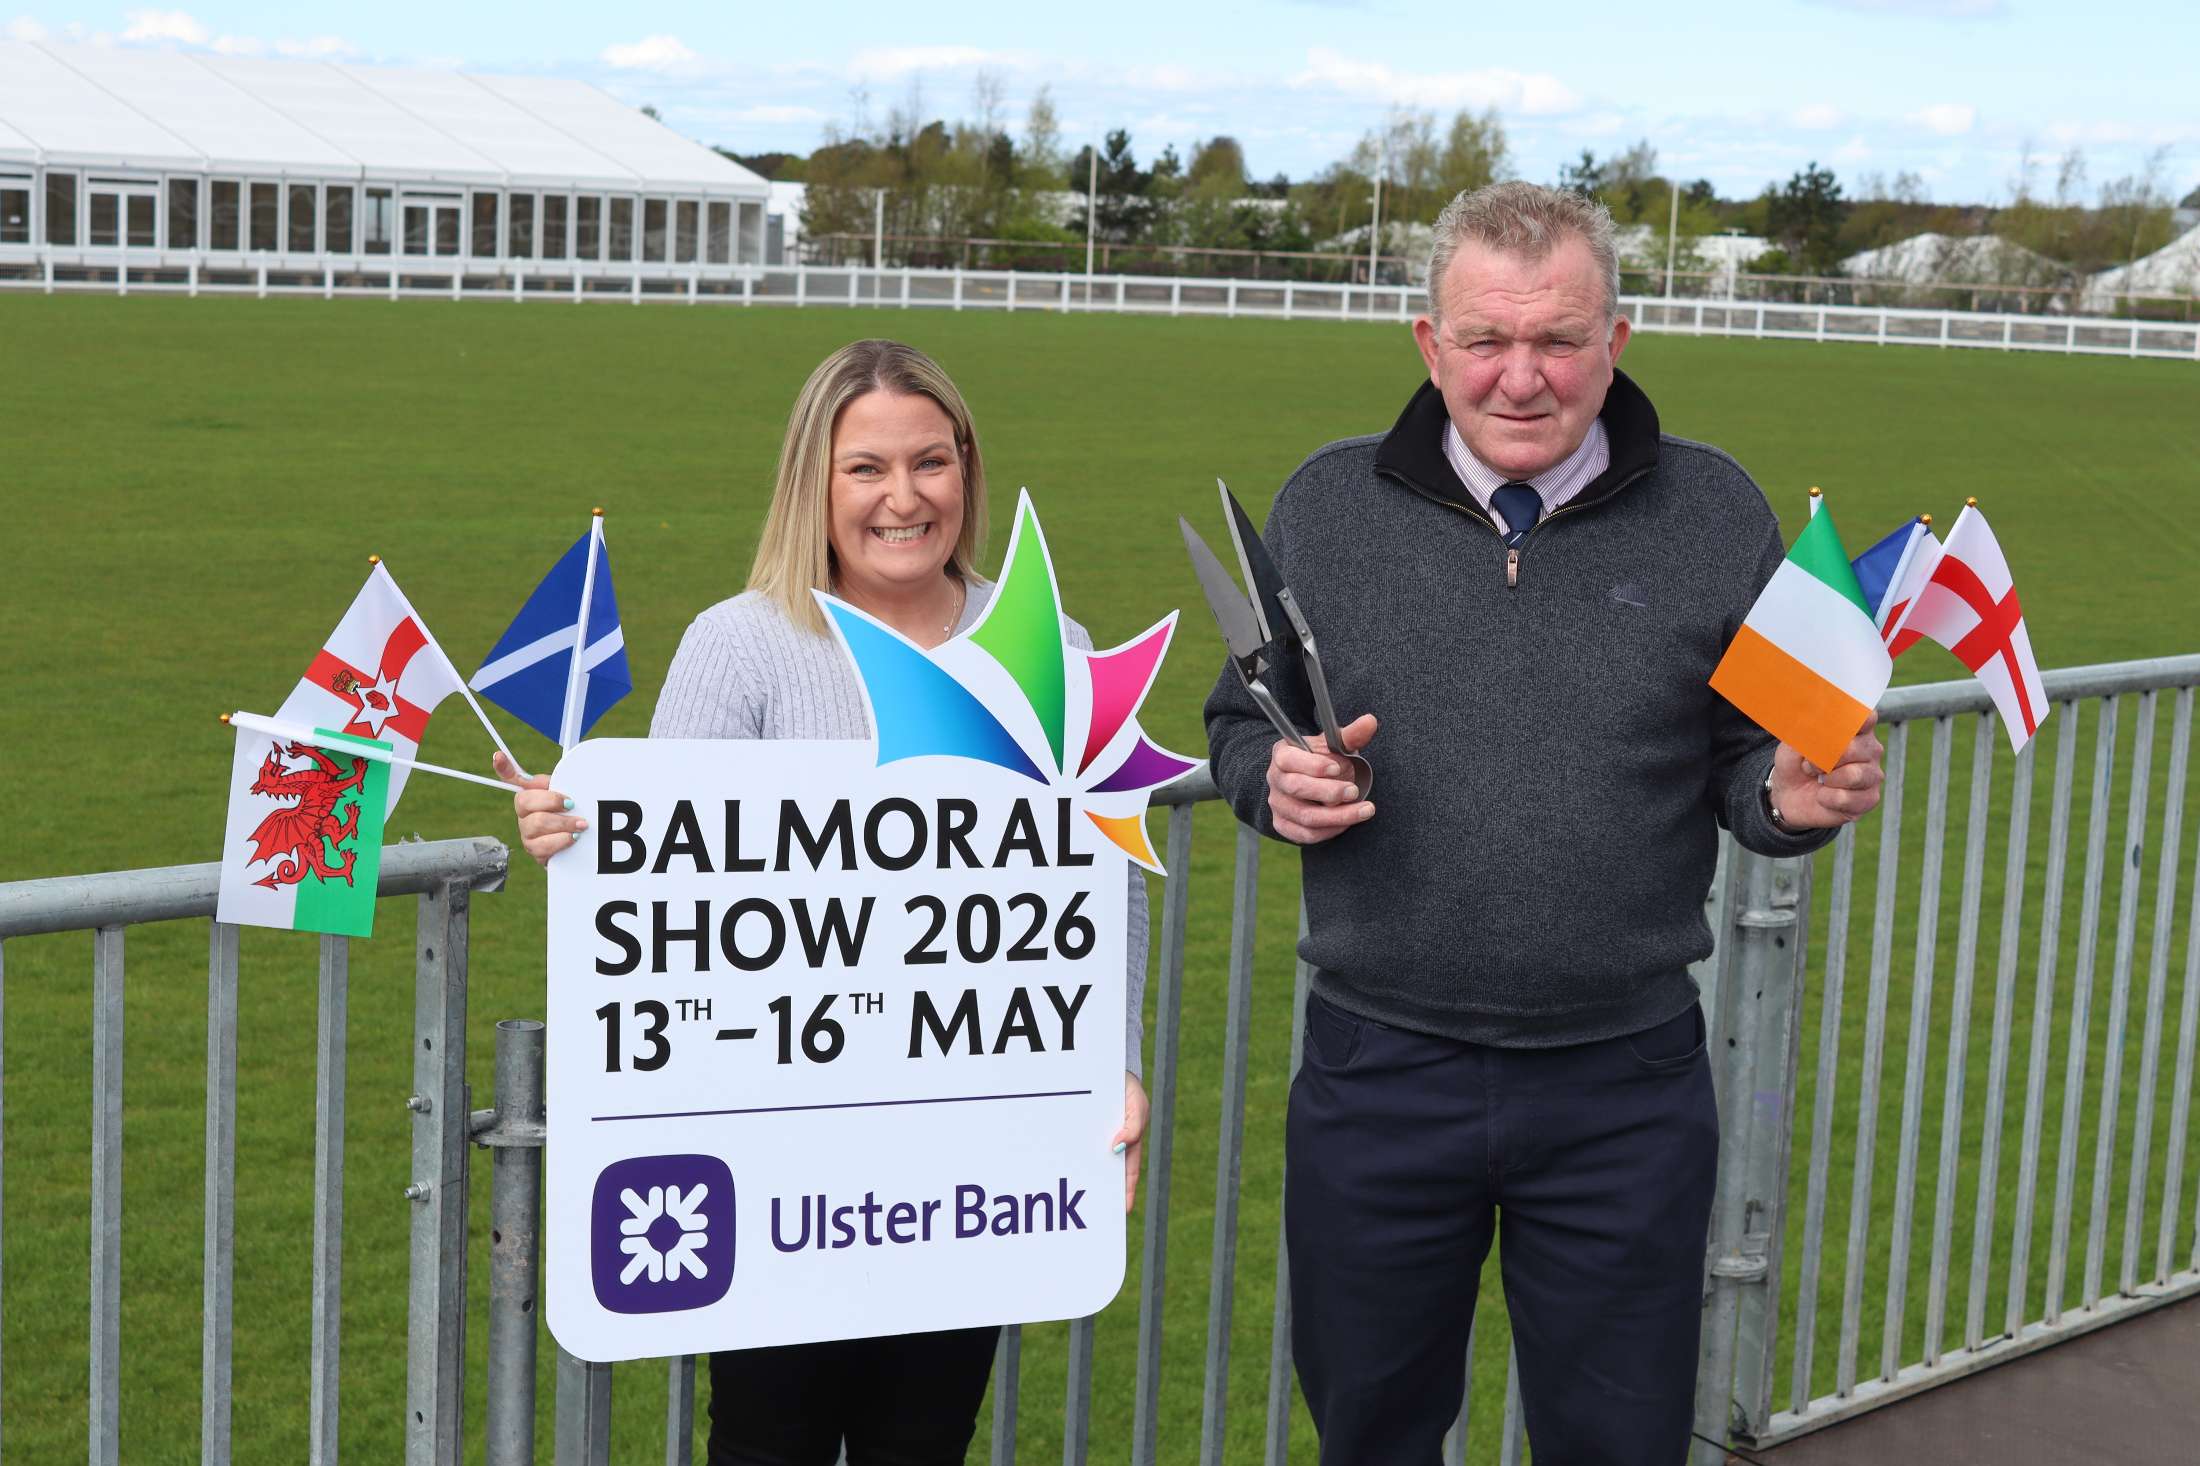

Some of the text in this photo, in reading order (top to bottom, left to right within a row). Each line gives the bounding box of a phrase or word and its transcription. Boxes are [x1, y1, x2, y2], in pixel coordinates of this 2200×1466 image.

[596, 797, 1095, 875] BALMORAL
[594, 891, 1096, 977] SHOW 2026
[907, 984, 1093, 1059] MAY
[769, 1177, 1087, 1253] Ulster Bank
